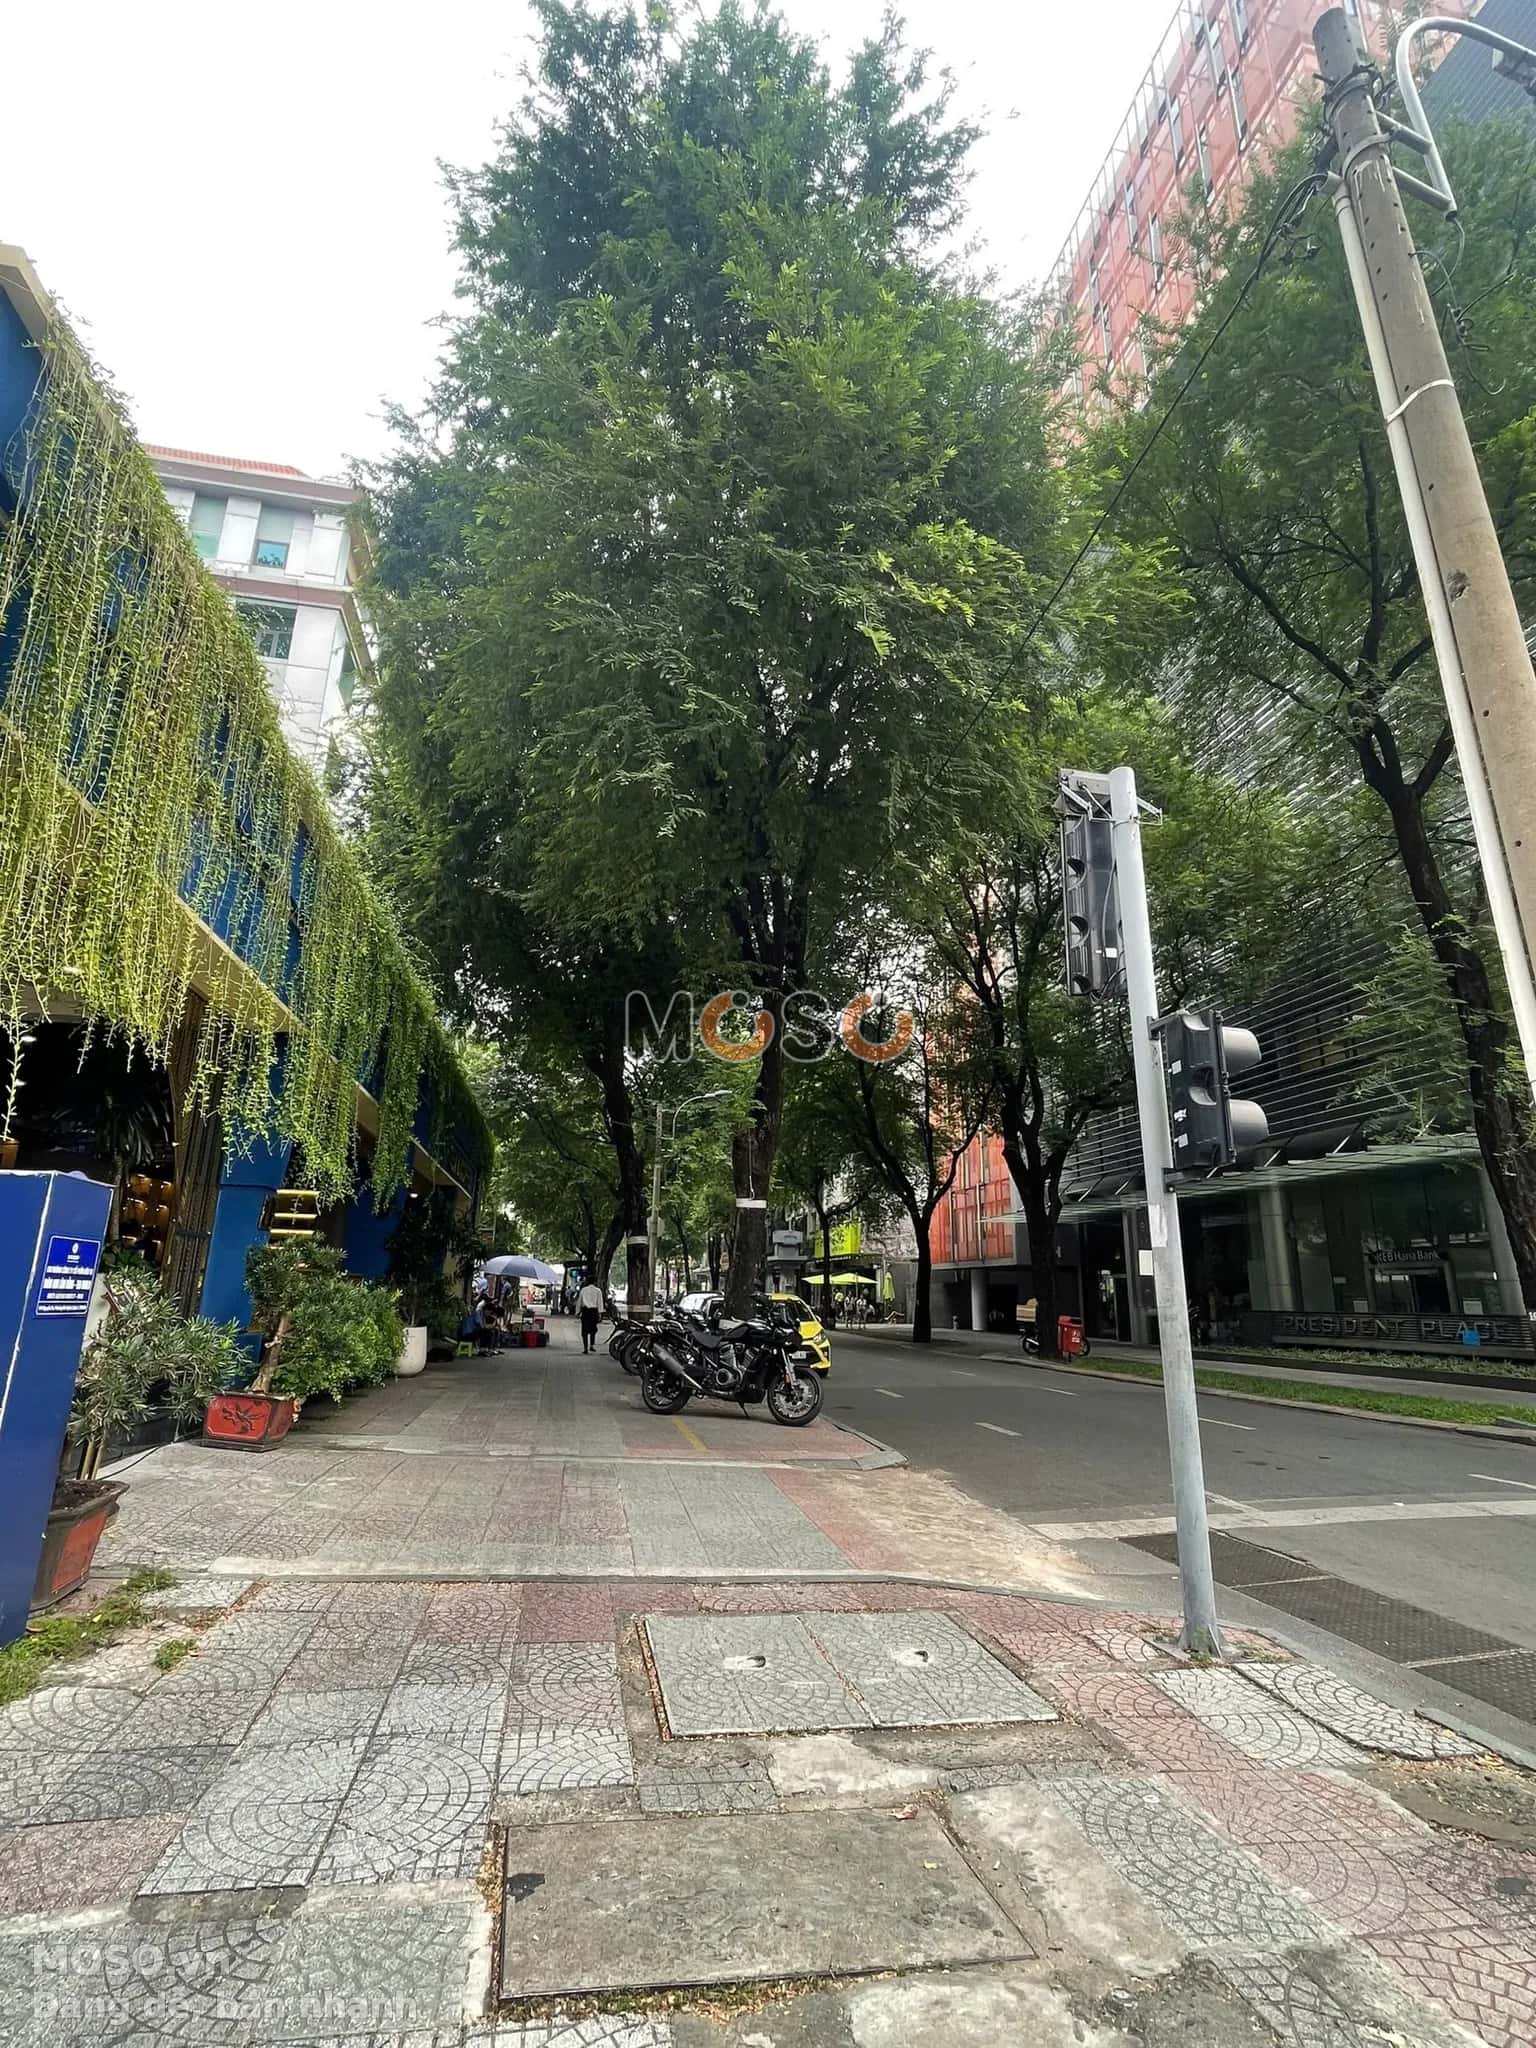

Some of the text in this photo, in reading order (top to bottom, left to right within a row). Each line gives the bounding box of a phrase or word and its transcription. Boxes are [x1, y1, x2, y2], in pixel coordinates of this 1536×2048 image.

[1417, 1248, 1440, 1261] Bank
[1284, 1315, 1508, 1340] PRESIDENT PLACE
